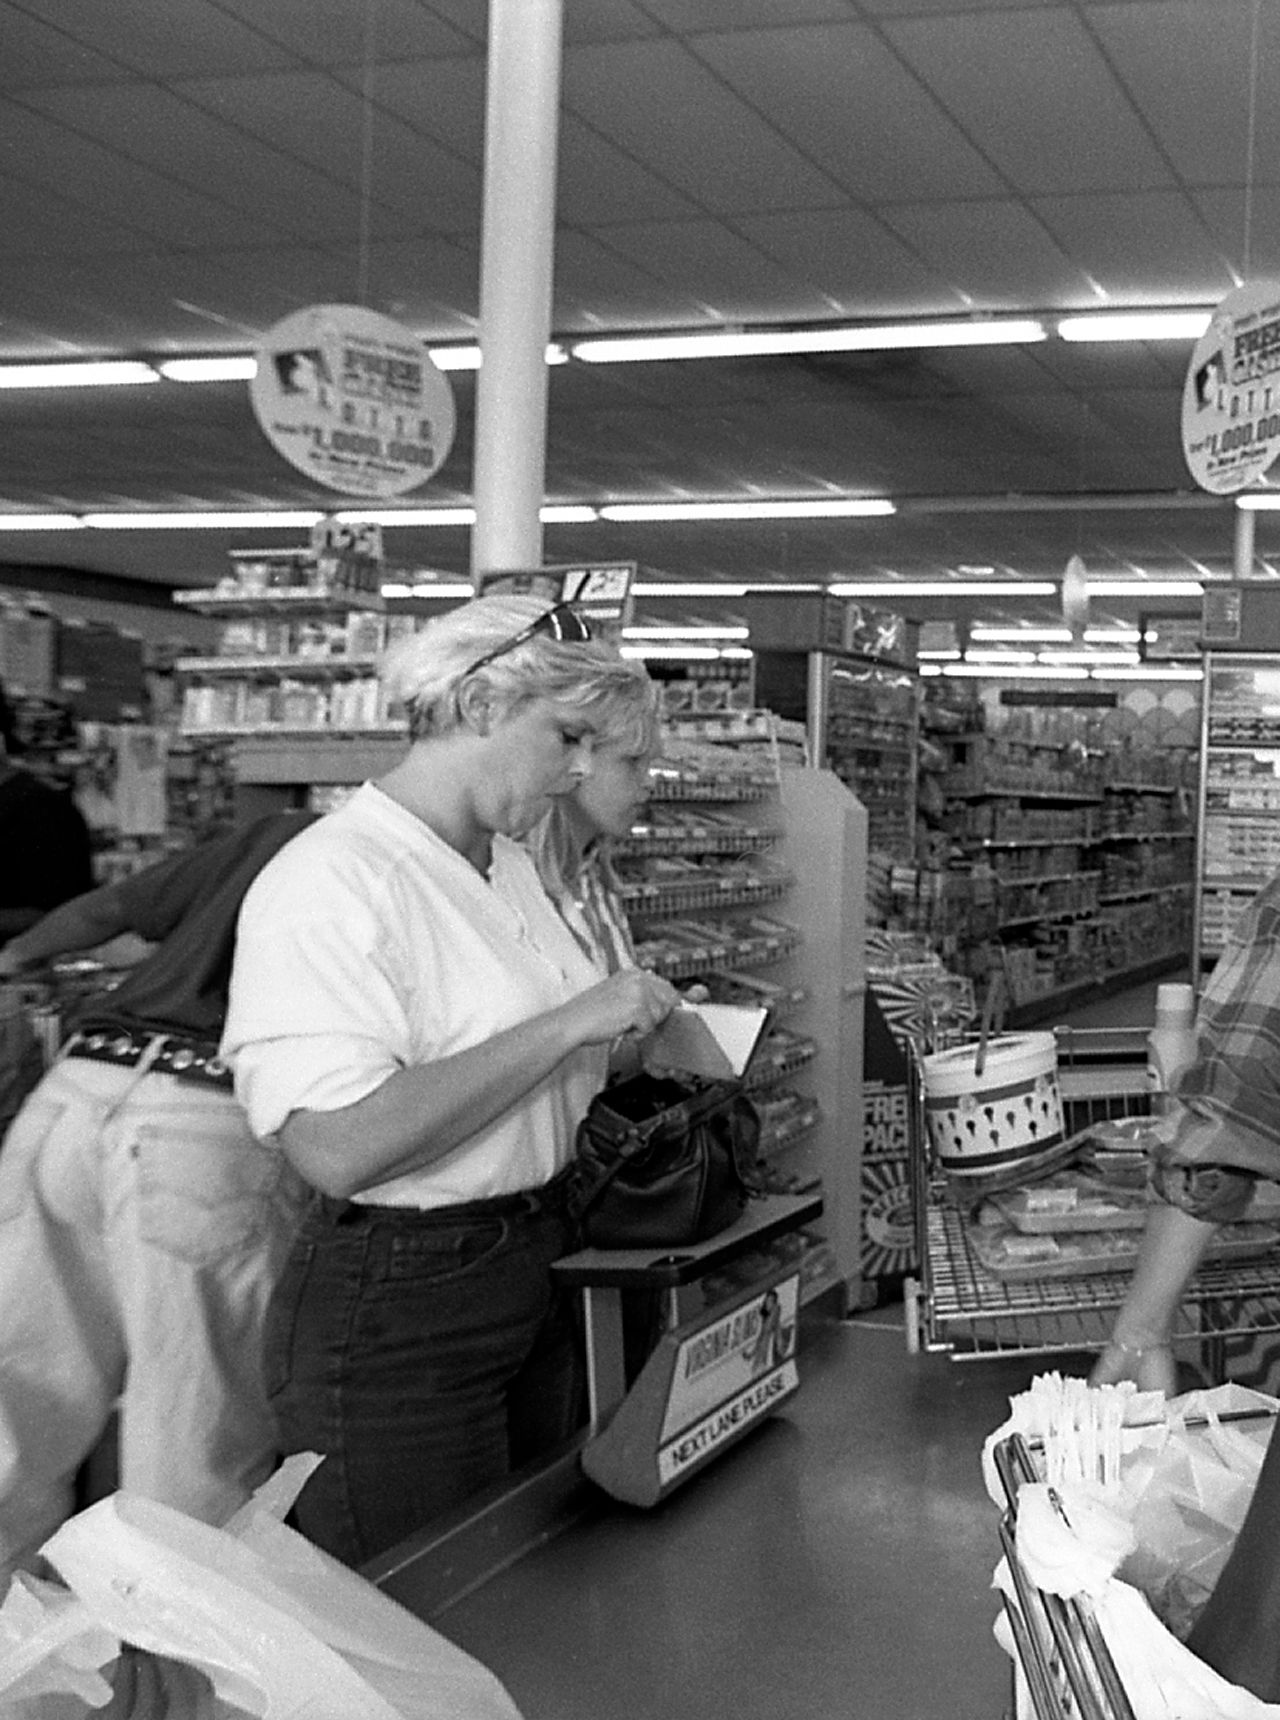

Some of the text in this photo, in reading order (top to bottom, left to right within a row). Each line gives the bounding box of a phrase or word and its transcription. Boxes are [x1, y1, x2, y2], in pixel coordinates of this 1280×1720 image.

[672, 1373, 785, 1468] NEXT LANE PLEASE
